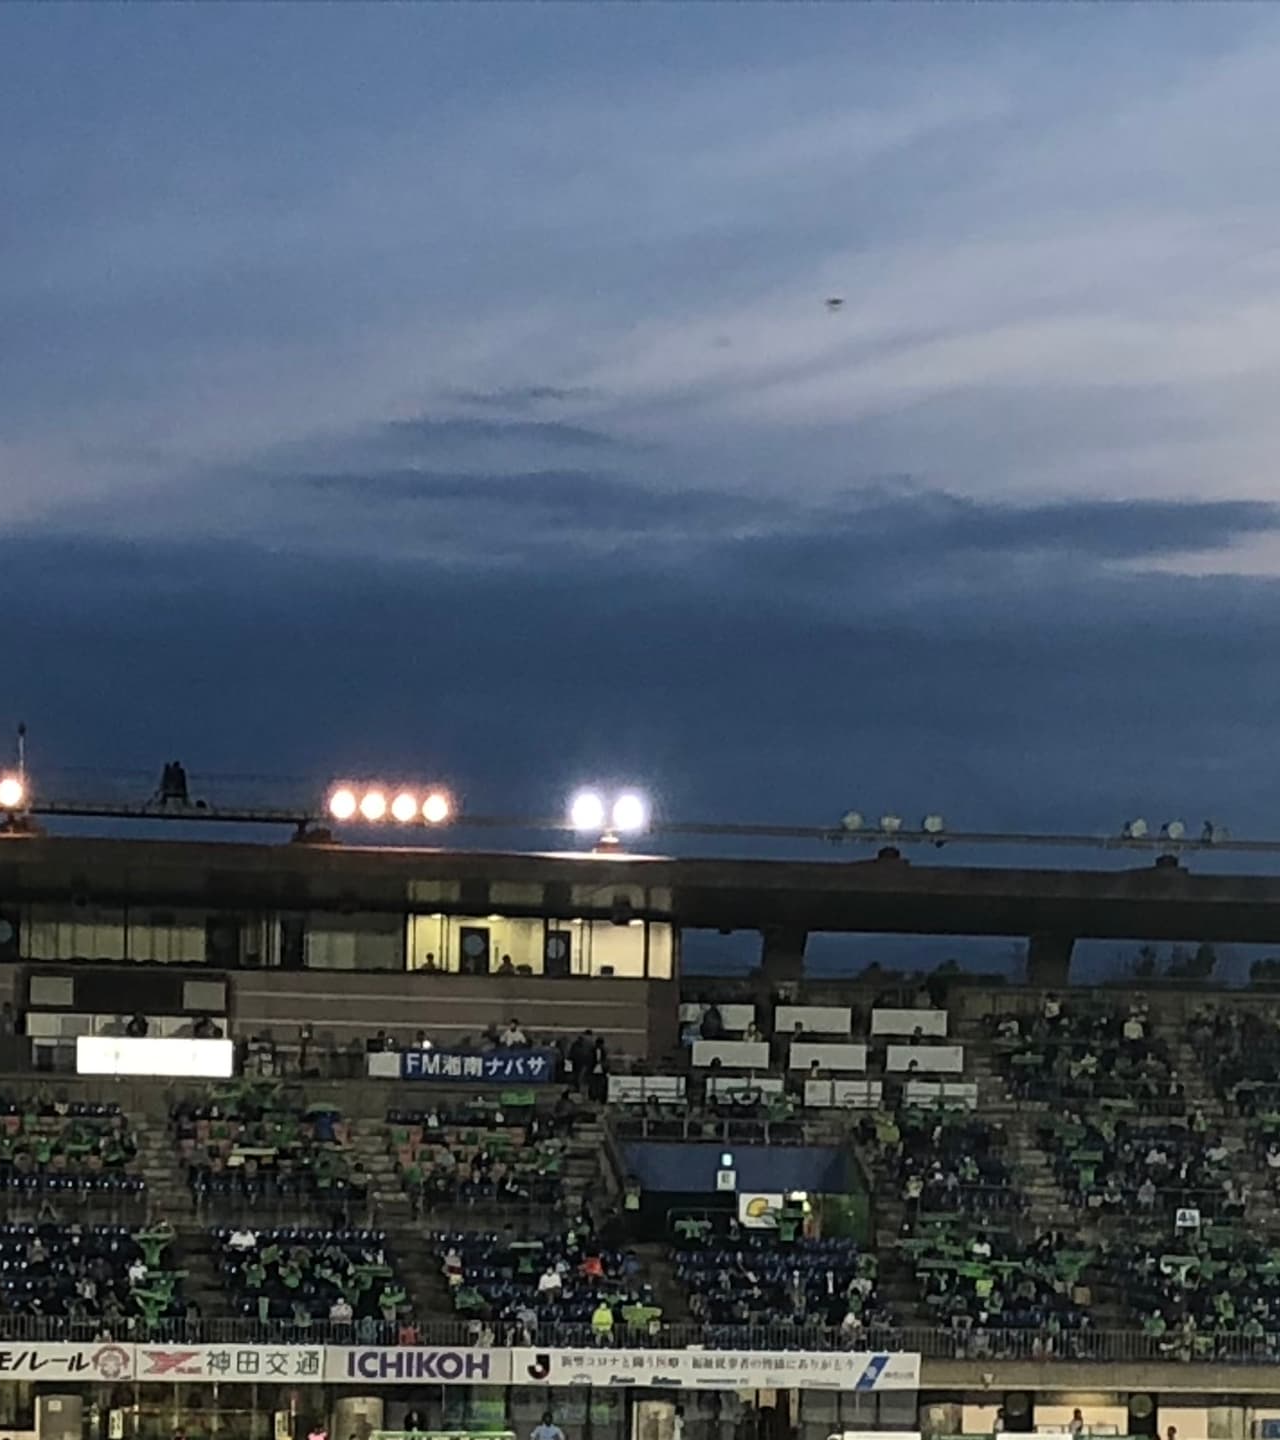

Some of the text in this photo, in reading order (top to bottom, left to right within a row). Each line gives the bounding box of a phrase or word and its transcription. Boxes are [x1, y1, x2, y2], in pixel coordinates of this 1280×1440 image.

[206, 1350, 320, 1376] 神田交通
[347, 1351, 490, 1379] ICHIKOH
